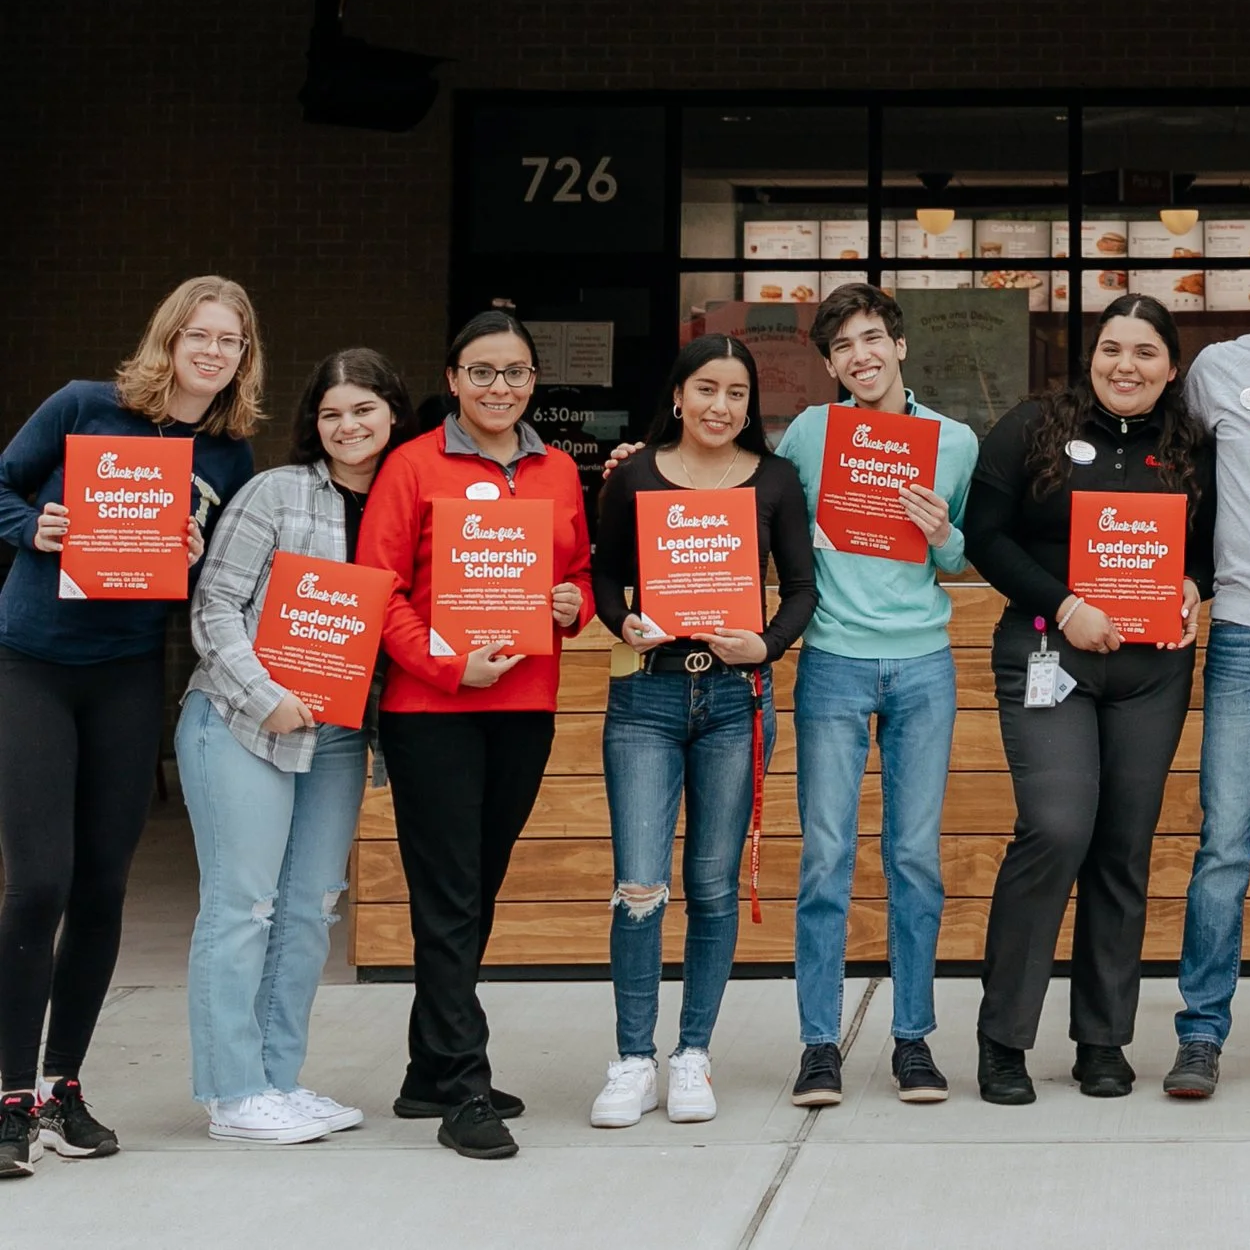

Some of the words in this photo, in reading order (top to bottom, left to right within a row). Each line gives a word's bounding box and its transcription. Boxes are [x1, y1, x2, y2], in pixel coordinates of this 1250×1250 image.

[522, 156, 617, 203] 726
[533, 407, 595, 423] 6:30am
[852, 423, 910, 454] Chick-fil-A
[97, 451, 162, 481] Chick-fil-A
[840, 453, 919, 479] Leadership
[850, 468, 906, 489] Scholar
[85, 487, 173, 507] Leadership
[98, 503, 160, 518] Scholar
[666, 504, 728, 528] Chick-fil-A
[1098, 506, 1157, 533] Chick-fil-A
[462, 513, 524, 541] Chick-fil-A
[657, 534, 740, 554] Leadership
[671, 546, 729, 563] Scholar
[1088, 539, 1168, 558] Leadership
[451, 548, 536, 567] Leadership
[1099, 553, 1156, 568] Scholar
[464, 562, 524, 577] Scholar
[296, 572, 357, 606] Chick-fil-A
[280, 603, 365, 635] Leadership
[289, 621, 351, 644] Scholar
